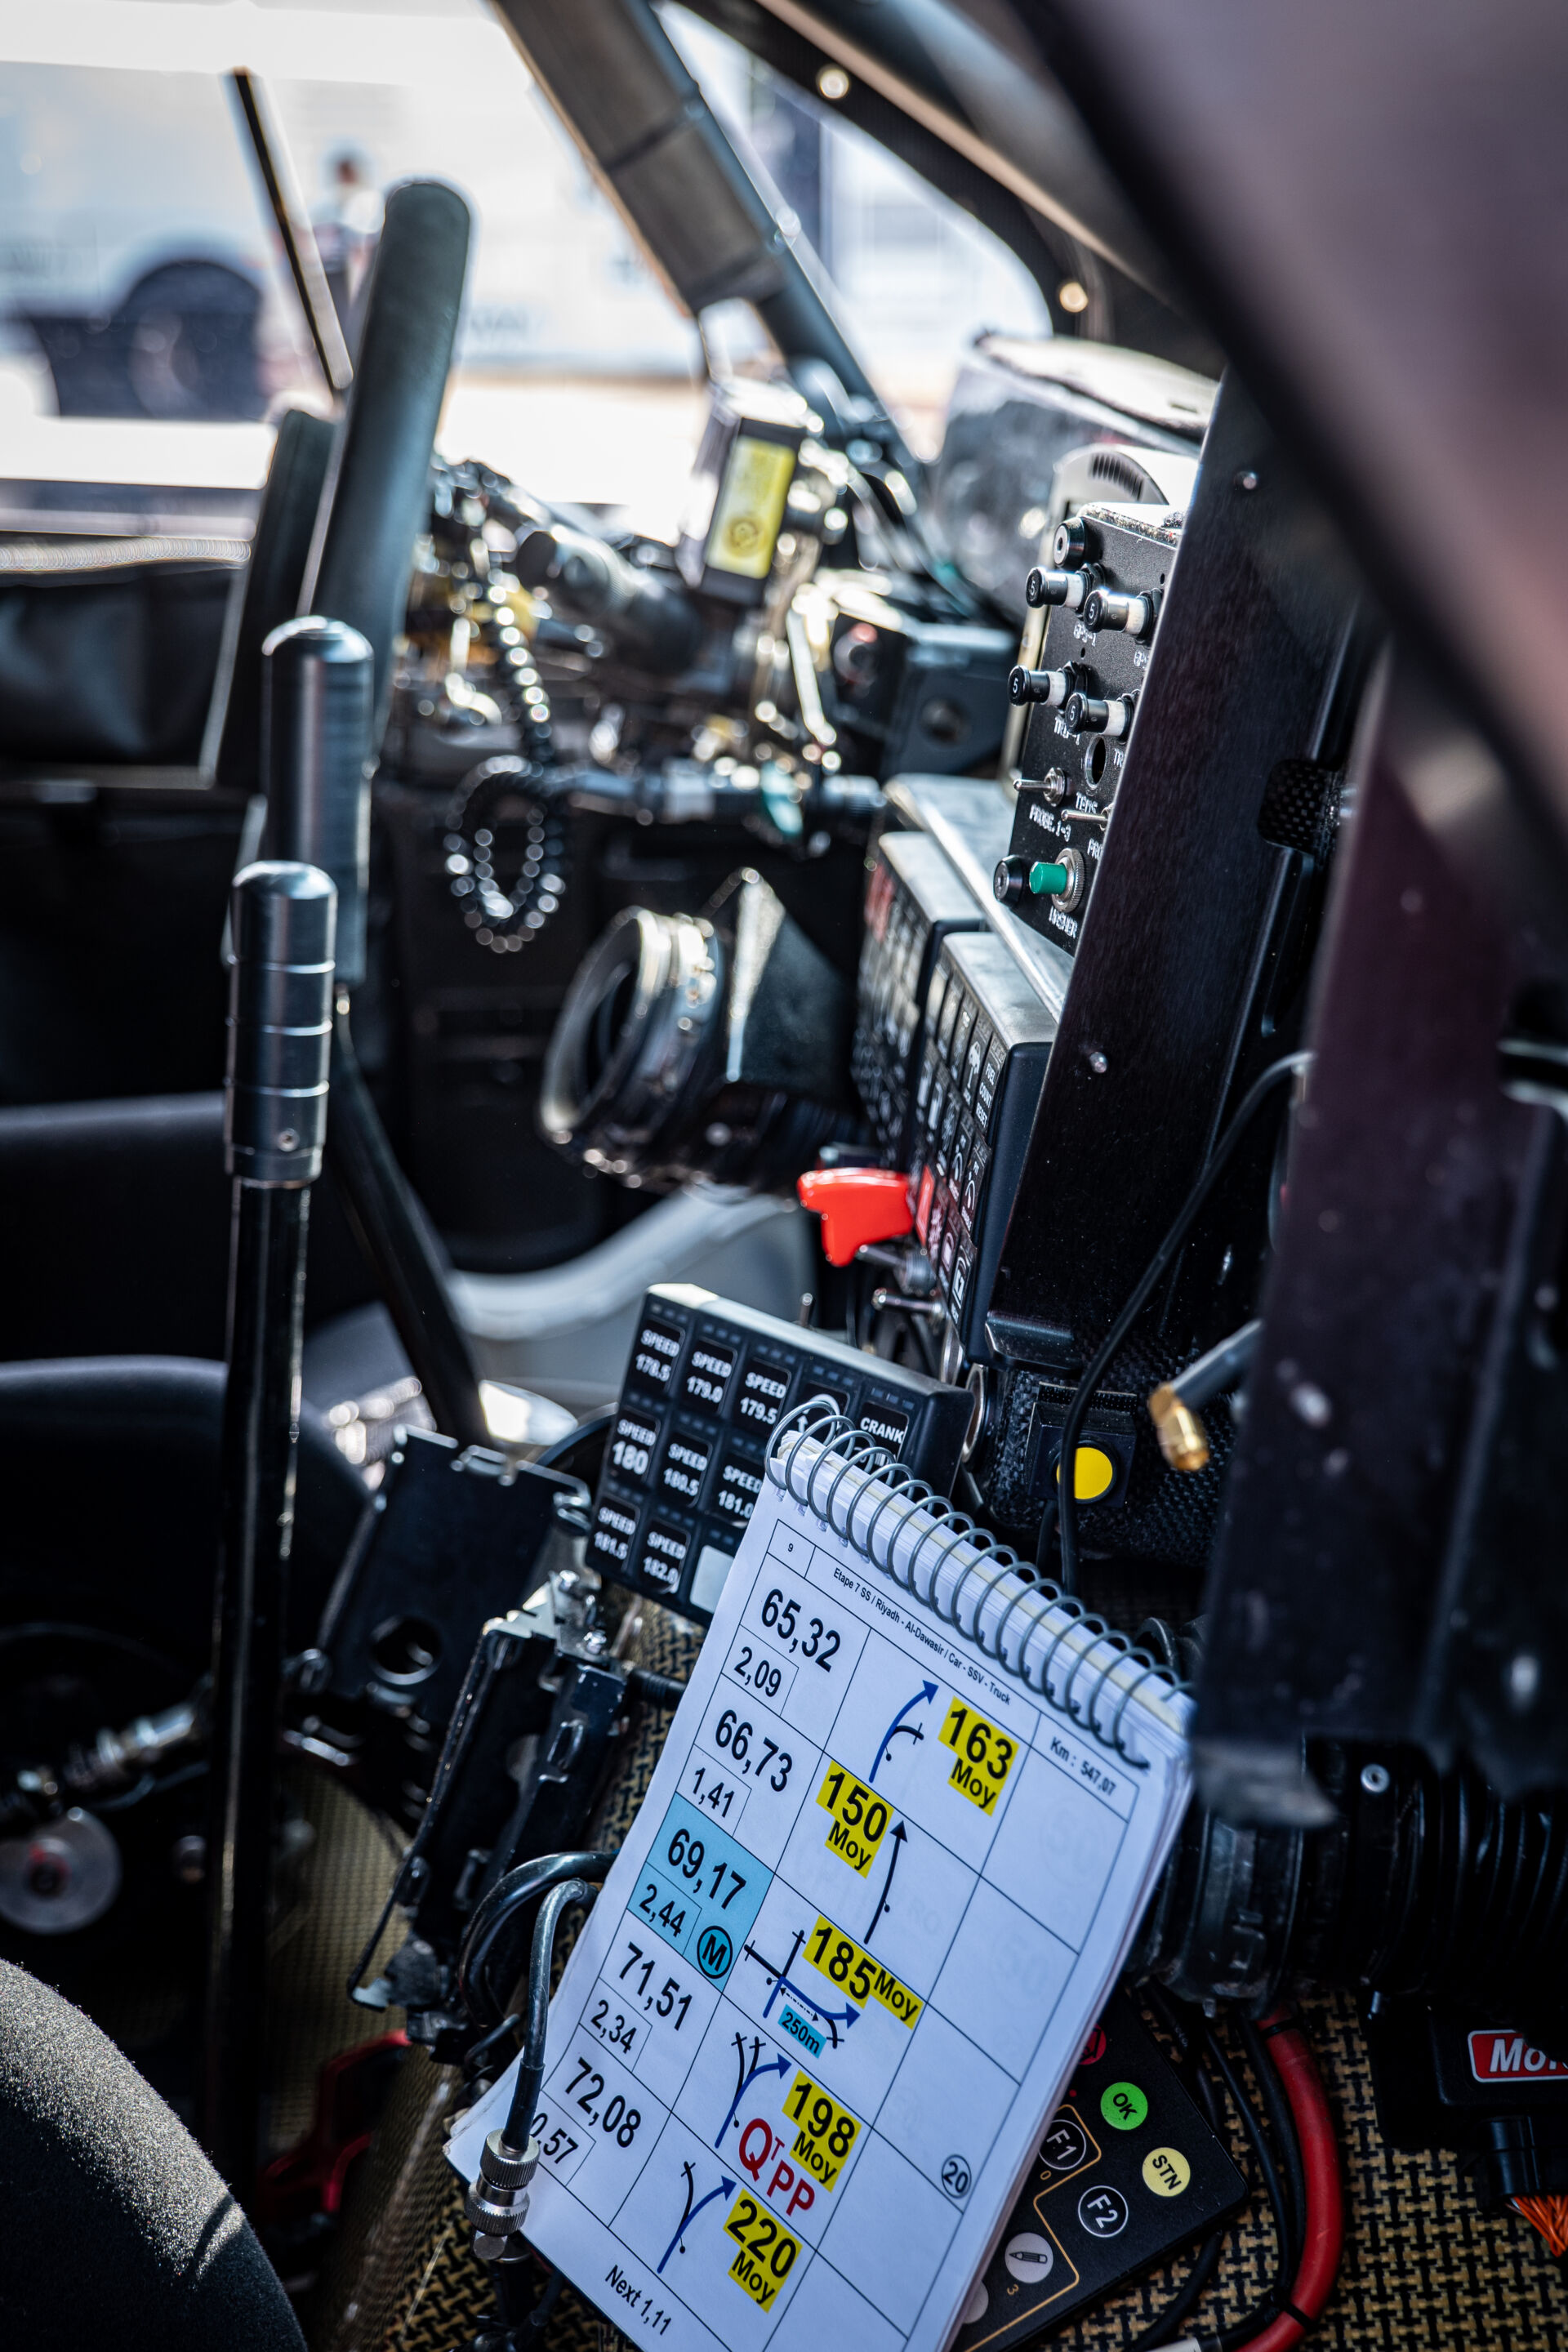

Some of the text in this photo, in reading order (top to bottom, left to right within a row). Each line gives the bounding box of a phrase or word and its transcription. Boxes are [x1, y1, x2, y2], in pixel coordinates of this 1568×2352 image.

[1030, 580, 1036, 595] 5
[1089, 603, 1095, 619] 5
[1012, 678, 1018, 693] 5
[1069, 705, 1076, 721] 5
[975, 1102, 988, 1129] RESET
[640, 1329, 680, 1357] SPEED
[692, 1351, 732, 1378] SPEED
[687, 1375, 724, 1403] 179.0
[745, 1372, 786, 1399] SPEED
[740, 1396, 777, 1425] 179.5
[617, 1419, 656, 1446] SPEED
[860, 1417, 905, 1444] CRANK
[612, 1441, 649, 1475] 180
[668, 1443, 707, 1471] SPEED
[723, 1465, 763, 1494] SPEED
[598, 1507, 636, 1535] SPEED
[718, 1490, 755, 1519] 181.0
[647, 1531, 686, 1560] SPEED
[787, 1543, 794, 1552] 9
[761, 1588, 841, 1673] 65,32
[833, 1567, 854, 1589] Etape
[853, 1582, 861, 1592] 7
[860, 1586, 871, 1601] SS
[875, 1598, 900, 1624] Riyadh
[905, 1621, 945, 1655] Al-Dawasir
[948, 1652, 962, 1668] Car
[967, 1666, 984, 1684] SSV
[989, 1682, 1011, 1705] Truck
[734, 1646, 782, 1698] 2,09
[715, 1709, 793, 1793] 66,73
[947, 1708, 1013, 1779] 163
[1050, 1736, 1069, 1762] Km
[693, 1766, 735, 1819] 1,41
[951, 1758, 996, 1810] Moy
[825, 1771, 888, 1843] 150
[827, 1822, 873, 1873] Moy
[667, 1828, 746, 1909] 69,17
[639, 1883, 687, 1937] 2,44
[702, 1938, 730, 1972] M
[616, 1940, 693, 2031] 71,51
[811, 1927, 919, 2024] 185 Moy
[590, 1999, 639, 2054] 2,34
[781, 2011, 821, 2055] 250m
[1490, 2038, 1568, 2072] Mo
[564, 2056, 641, 2148] 72,08
[1112, 2092, 1138, 2121] OK
[786, 2082, 857, 2158] 198
[792, 2135, 839, 2185] Moy
[1046, 2128, 1077, 2161] F1
[943, 2159, 969, 2194] 20
[1152, 2154, 1183, 2191] STN
[1086, 2194, 1118, 2229] F2
[727, 2198, 798, 2280] 220
[733, 2252, 775, 2305] Moy
[1007, 2283, 1019, 2296] 3
[605, 2265, 672, 2336] Next 1,11
